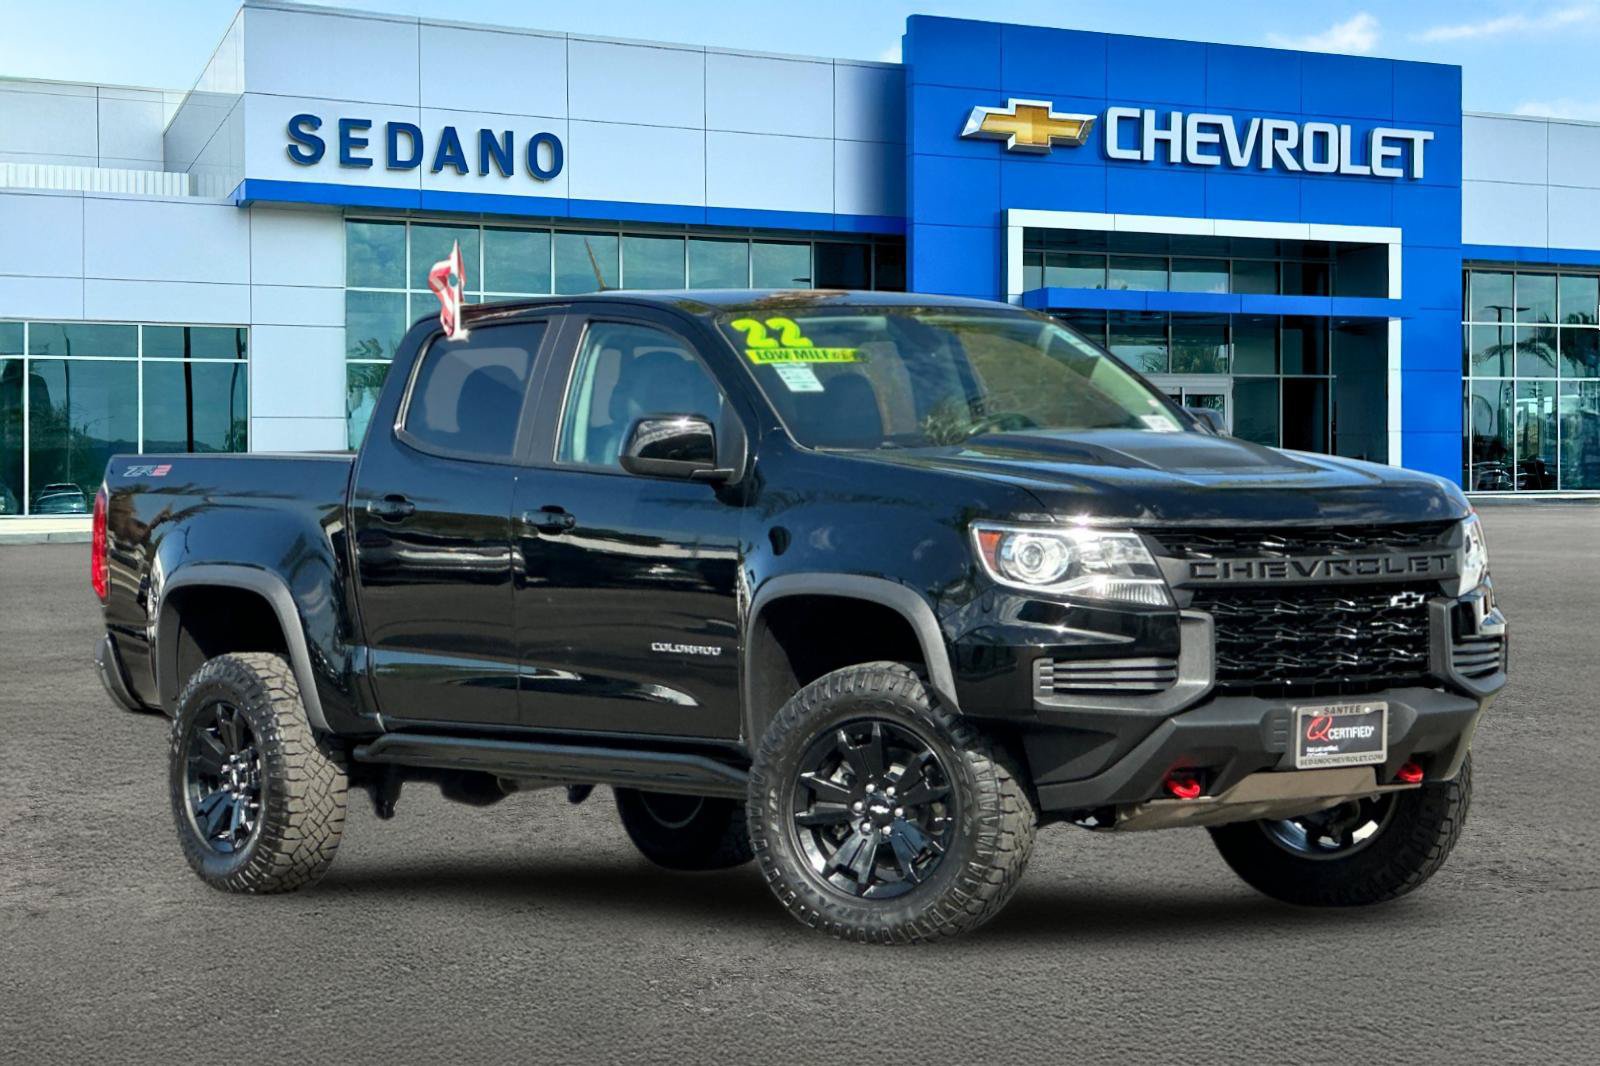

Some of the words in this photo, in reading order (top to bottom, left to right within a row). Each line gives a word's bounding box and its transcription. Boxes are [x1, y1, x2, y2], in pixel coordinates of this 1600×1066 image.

[287, 113, 564, 181] SEDANO
[1106, 106, 1434, 179] CHEVROLET
[731, 317, 813, 348] 22
[756, 350, 789, 360] LOW
[123, 464, 172, 477] ZR2
[1189, 554, 1452, 580] CHEVROLET
[651, 642, 721, 656] COLORADO
[1324, 705, 1361, 715] SANTEE
